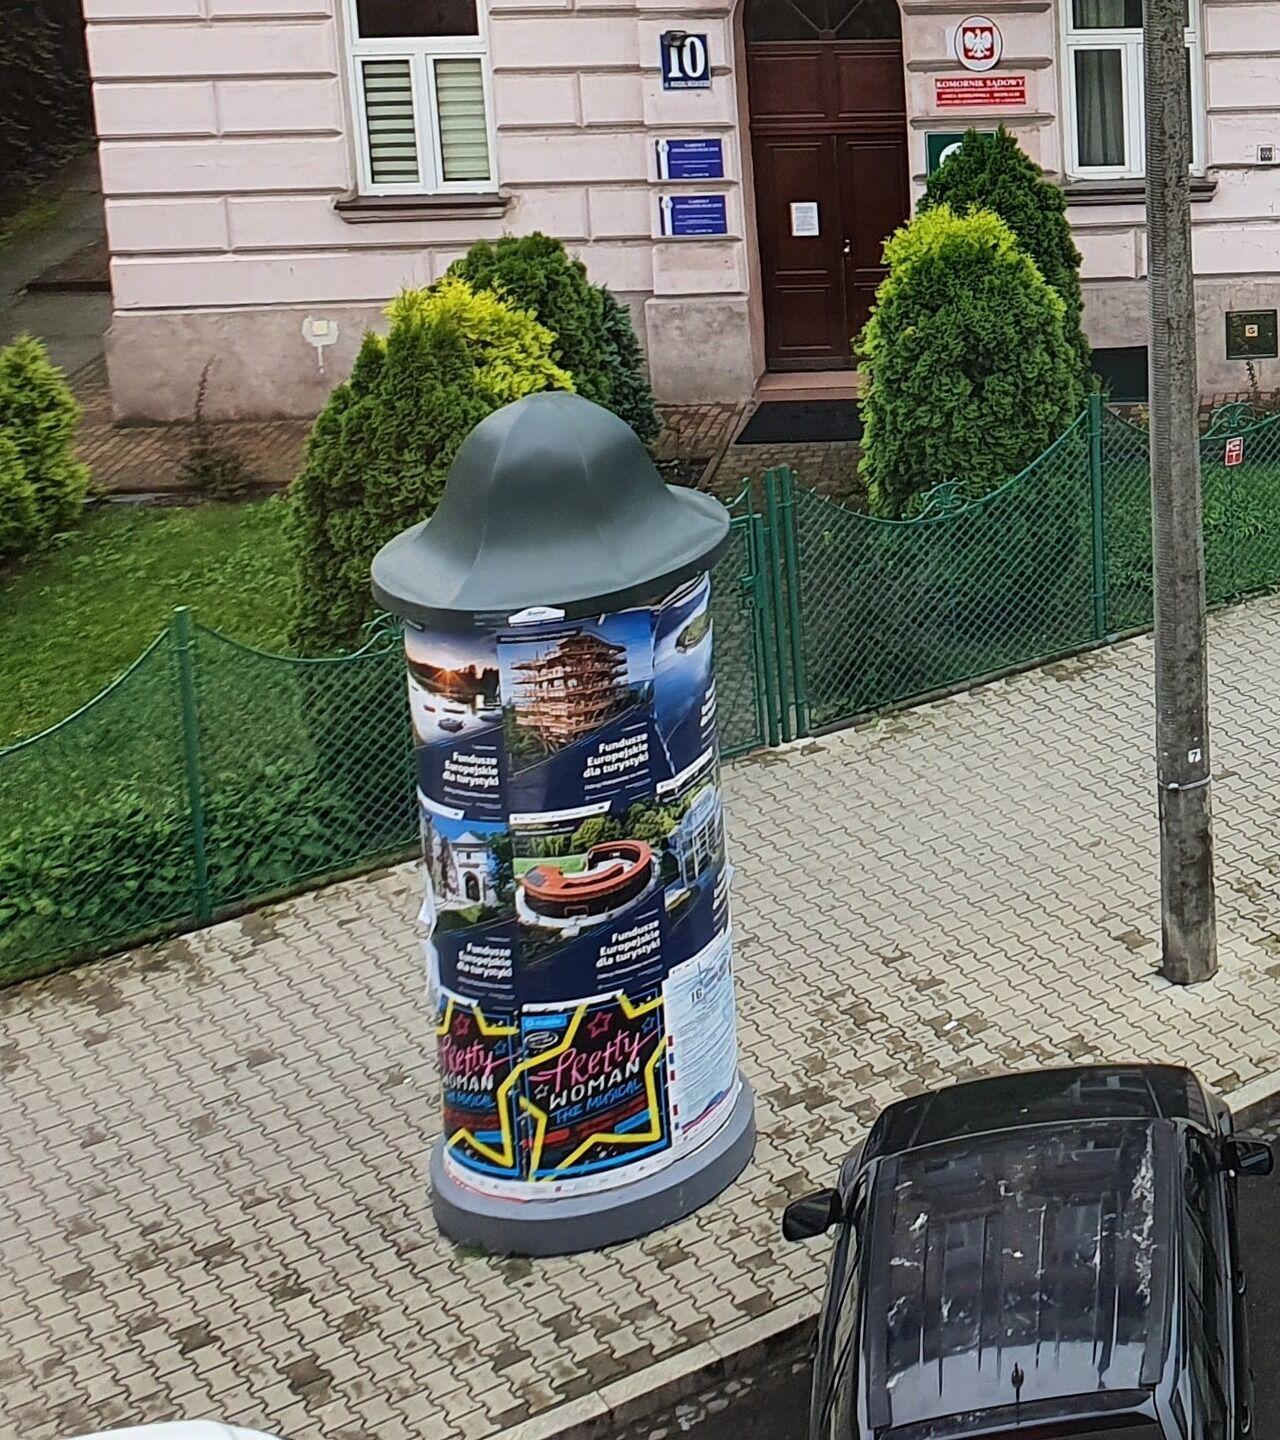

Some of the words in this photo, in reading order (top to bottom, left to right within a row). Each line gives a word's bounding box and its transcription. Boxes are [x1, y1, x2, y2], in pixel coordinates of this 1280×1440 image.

[667, 36, 706, 78] 10
[936, 79, 985, 88] KOMORNIK
[986, 78, 1024, 89] SĄDOWY
[586, 742, 649, 767] Europejskie
[598, 732, 649, 754] Fundusze
[582, 767, 602, 778] dla
[602, 750, 650, 773] turystyki
[549, 1056, 641, 1110] WOMAN
